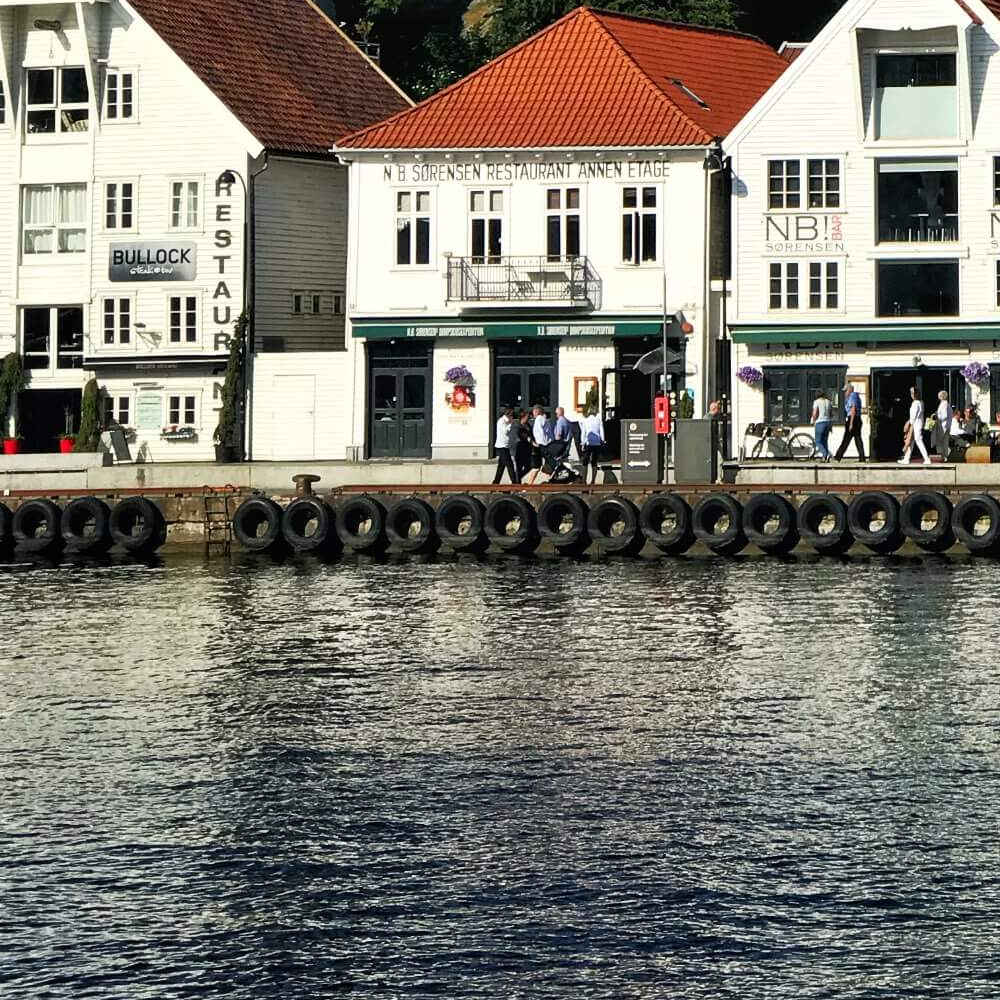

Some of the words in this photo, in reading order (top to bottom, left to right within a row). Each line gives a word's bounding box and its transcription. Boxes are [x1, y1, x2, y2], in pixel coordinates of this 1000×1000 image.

[412, 163, 481, 181] SØRENSEN
[487, 162, 572, 180] RESTAURANT
[578, 161, 622, 178] ANNEN
[628, 160, 671, 177] ETAGE
[766, 216, 828, 241] NB!
[832, 215, 843, 241] BAR
[113, 248, 191, 265] BULLOCK
[766, 242, 844, 252] SØRENSEN
